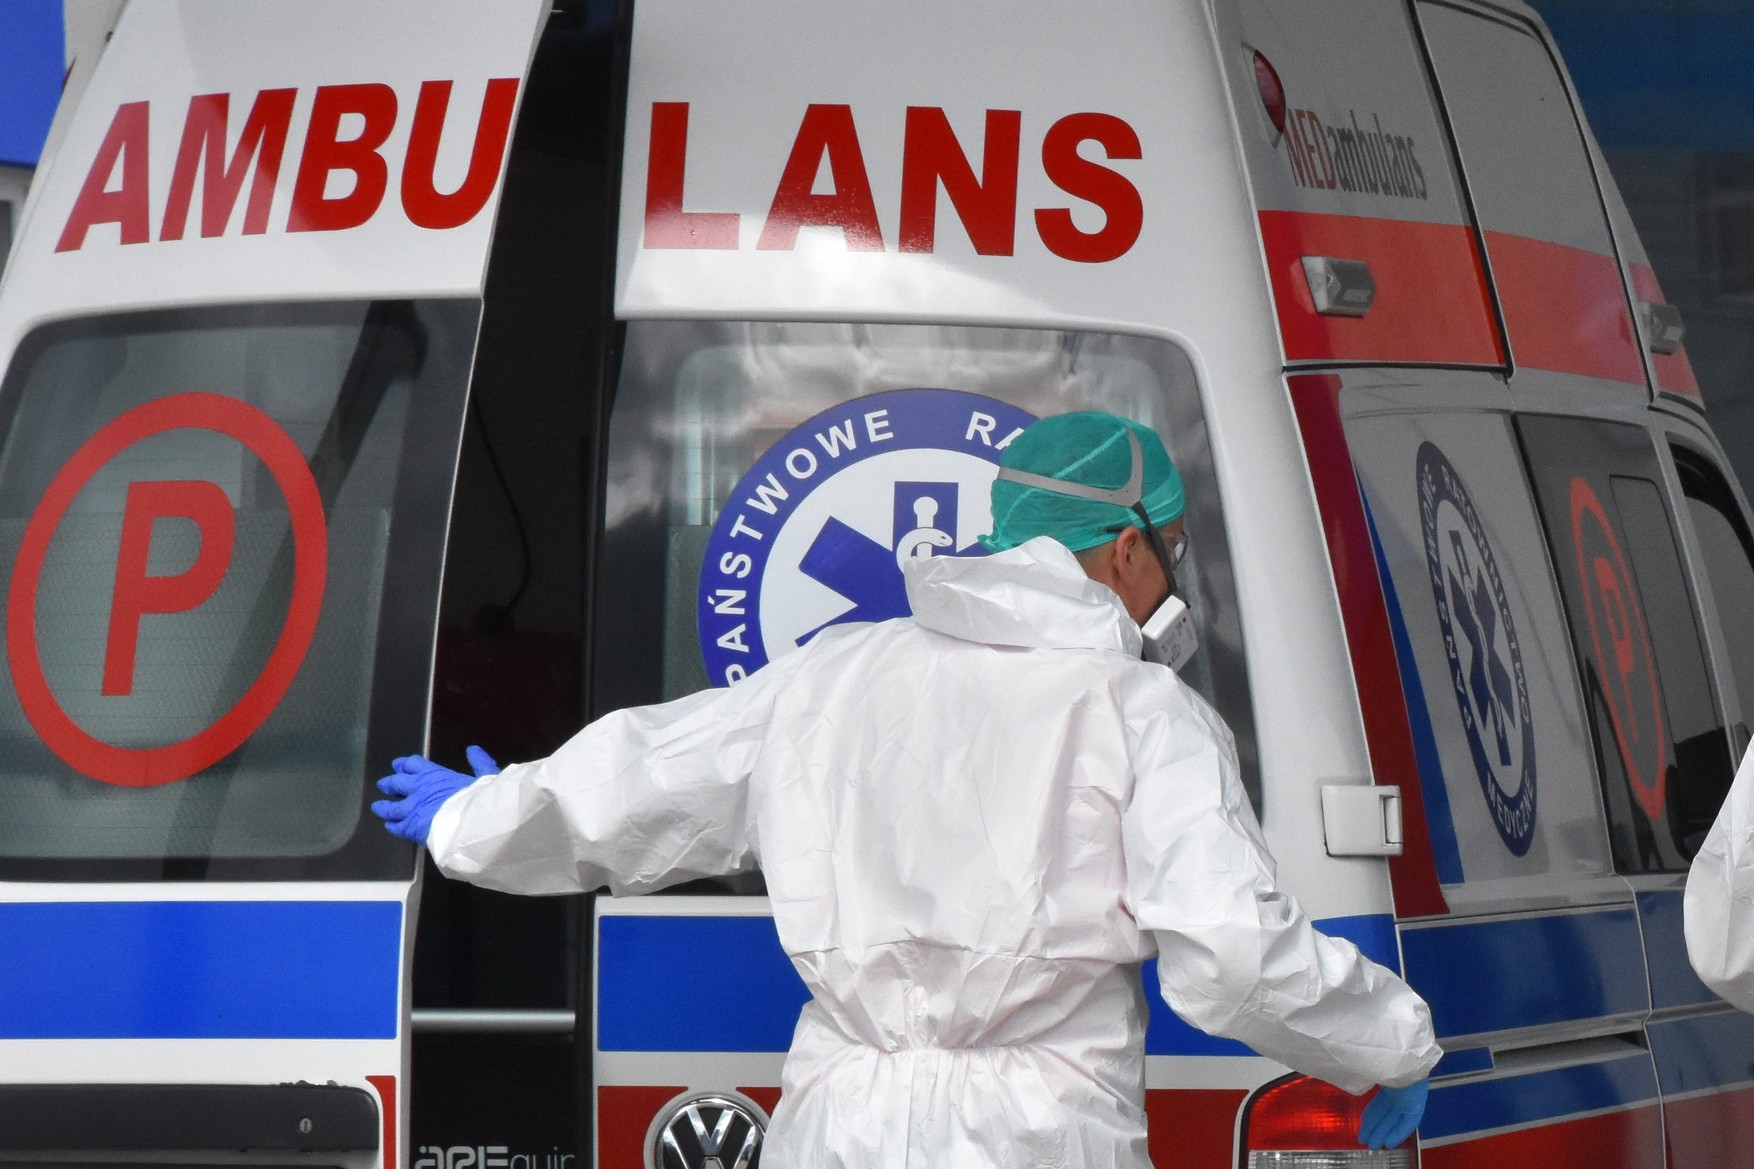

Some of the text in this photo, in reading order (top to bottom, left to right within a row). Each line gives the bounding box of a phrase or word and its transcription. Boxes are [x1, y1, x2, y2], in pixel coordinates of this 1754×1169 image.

[54, 77, 1144, 263] AMBU LANS
[102, 480, 236, 697] P
